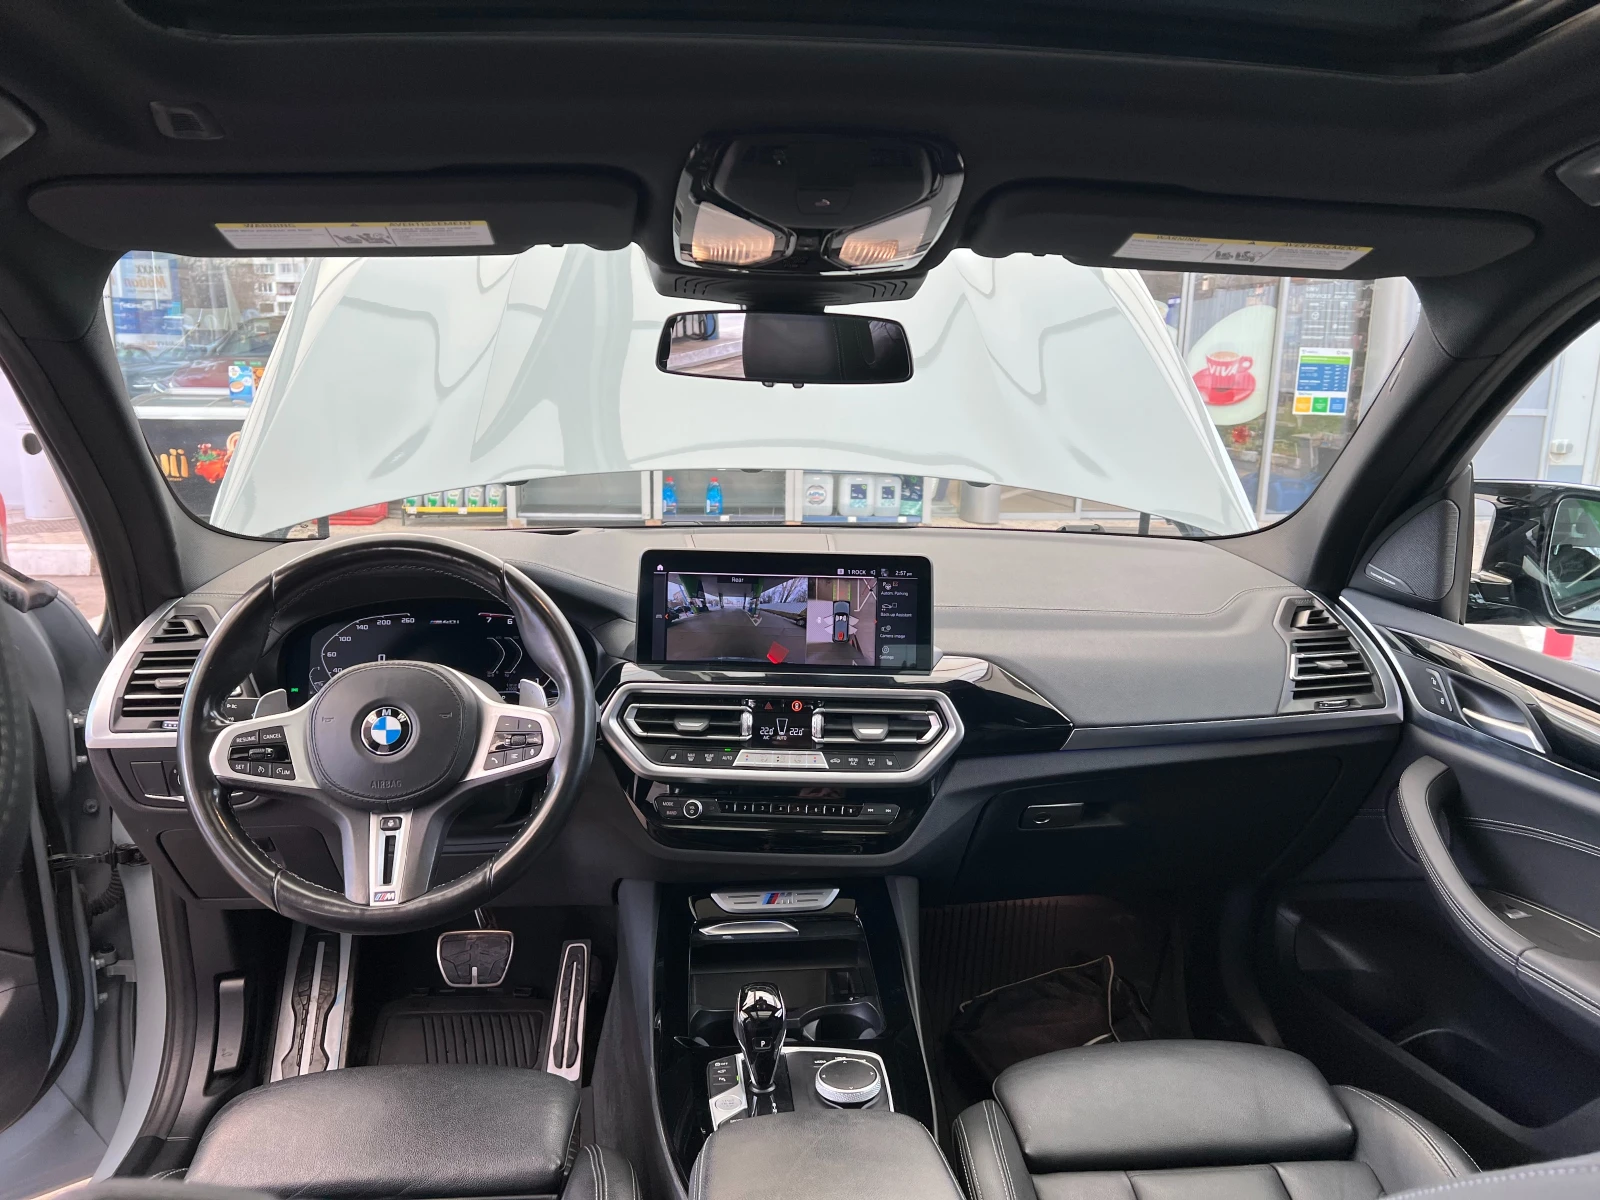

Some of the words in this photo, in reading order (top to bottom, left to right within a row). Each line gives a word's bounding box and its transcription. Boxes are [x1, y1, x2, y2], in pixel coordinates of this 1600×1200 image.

[1207, 363, 1239, 377] VIVA
[367, 708, 407, 723] BMW
[371, 779, 403, 790] AIRBAG
